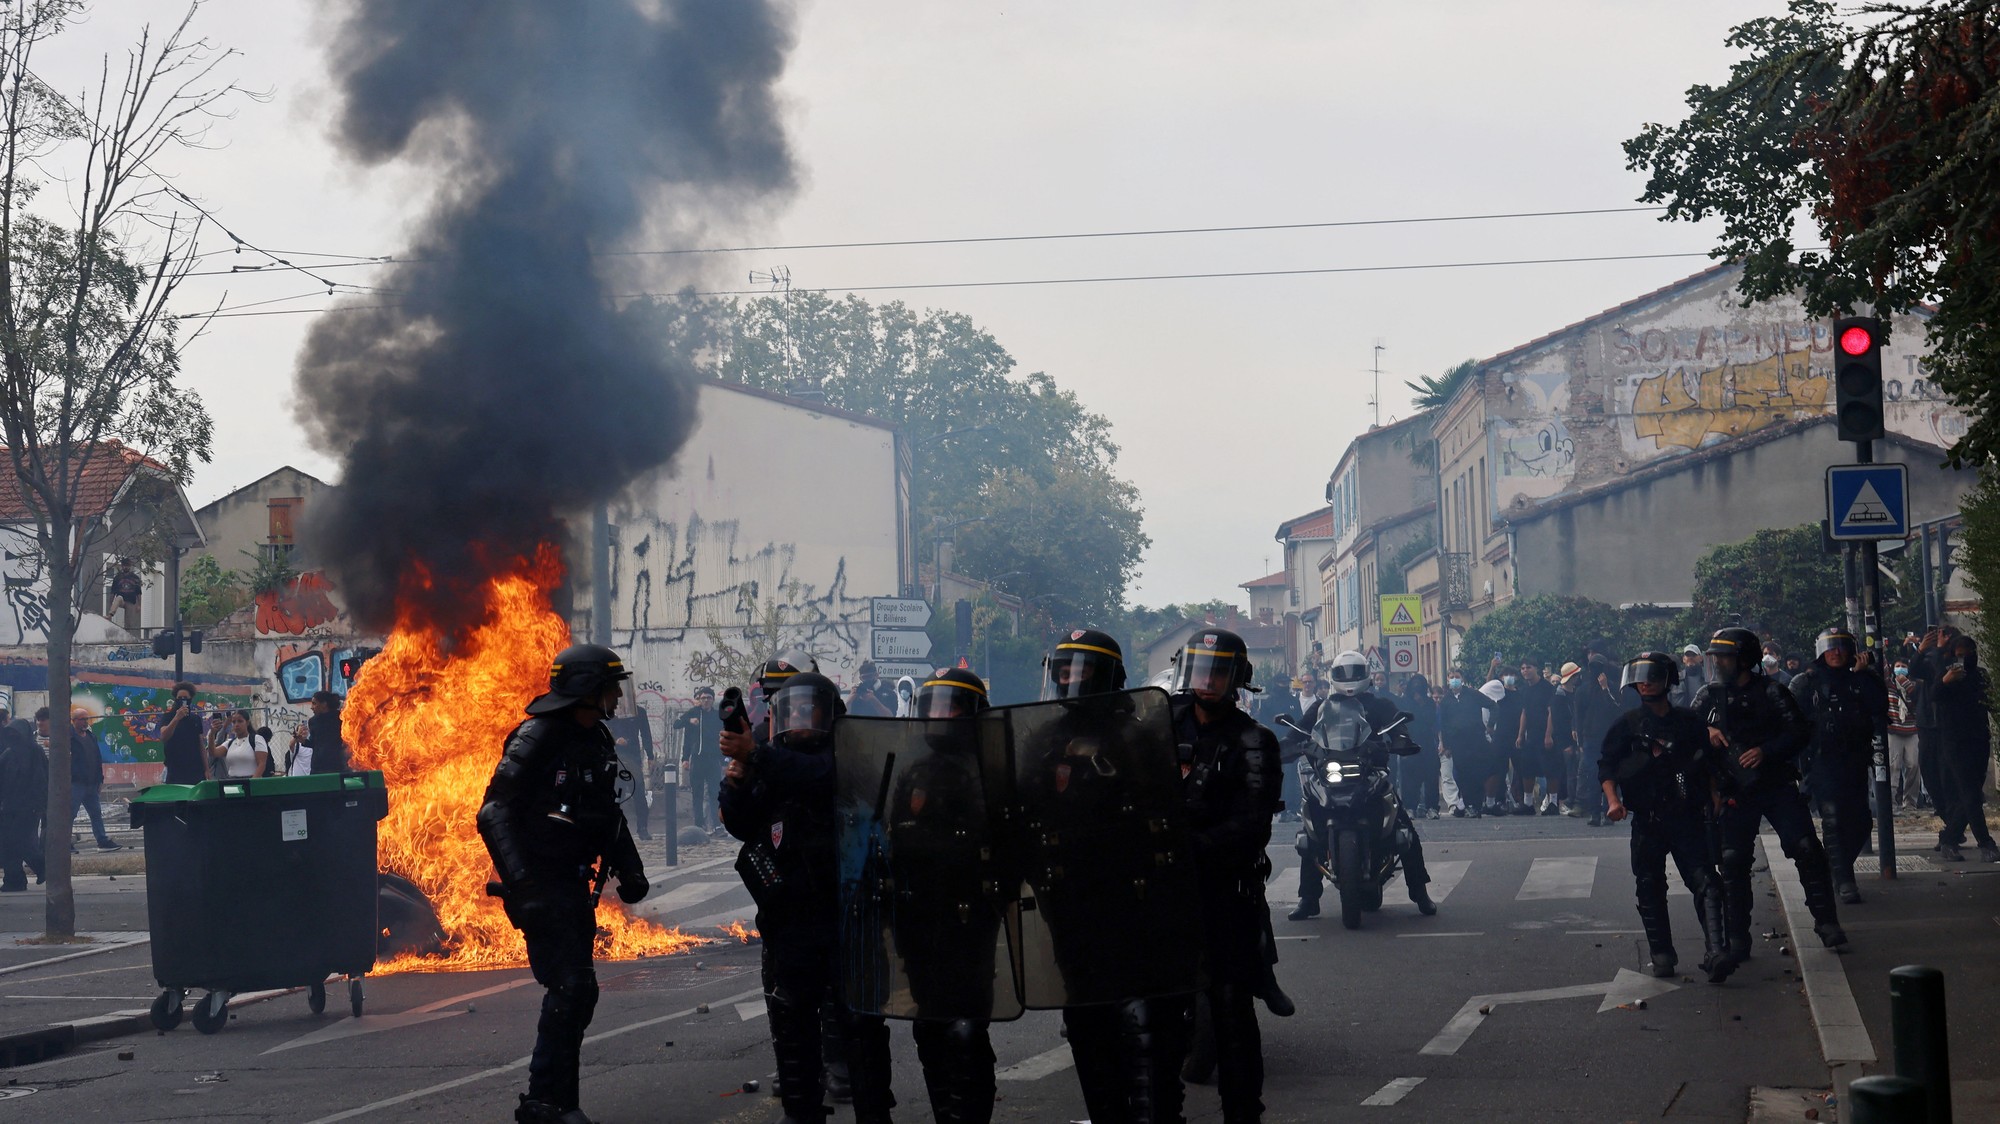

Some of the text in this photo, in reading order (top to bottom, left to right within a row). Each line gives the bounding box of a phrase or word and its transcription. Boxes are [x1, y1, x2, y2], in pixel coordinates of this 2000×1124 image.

[876, 602, 923, 613] Groupe Scolaire
[877, 634, 897, 645] Foyer
[877, 645, 884, 655] E.
[1398, 654, 1409, 662] 30
[878, 664, 917, 675] Commerces
